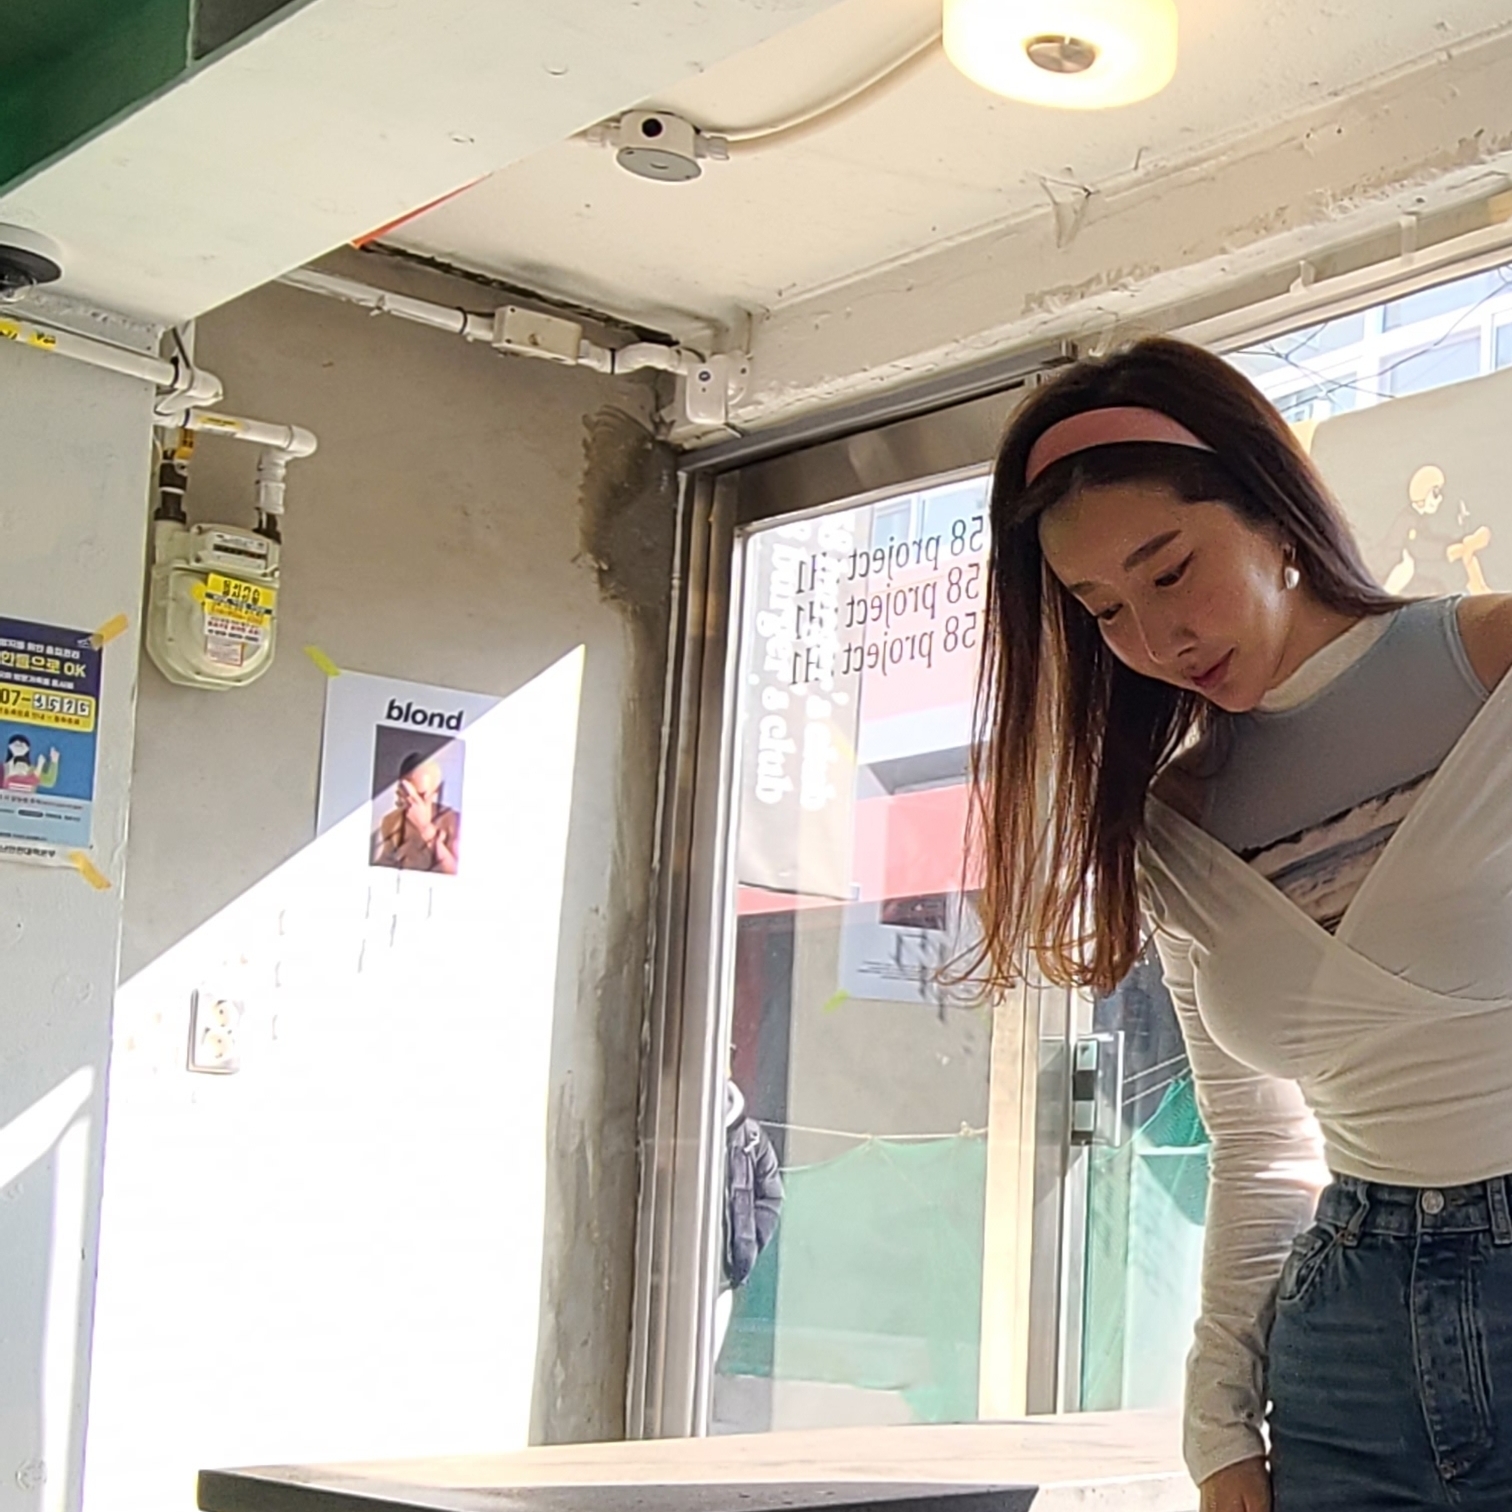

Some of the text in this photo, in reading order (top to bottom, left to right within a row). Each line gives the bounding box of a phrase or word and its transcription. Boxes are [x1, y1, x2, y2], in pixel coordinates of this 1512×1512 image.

[63, 661, 87, 678] OK
[386, 698, 464, 731] blond
[755, 714, 797, 804] club
